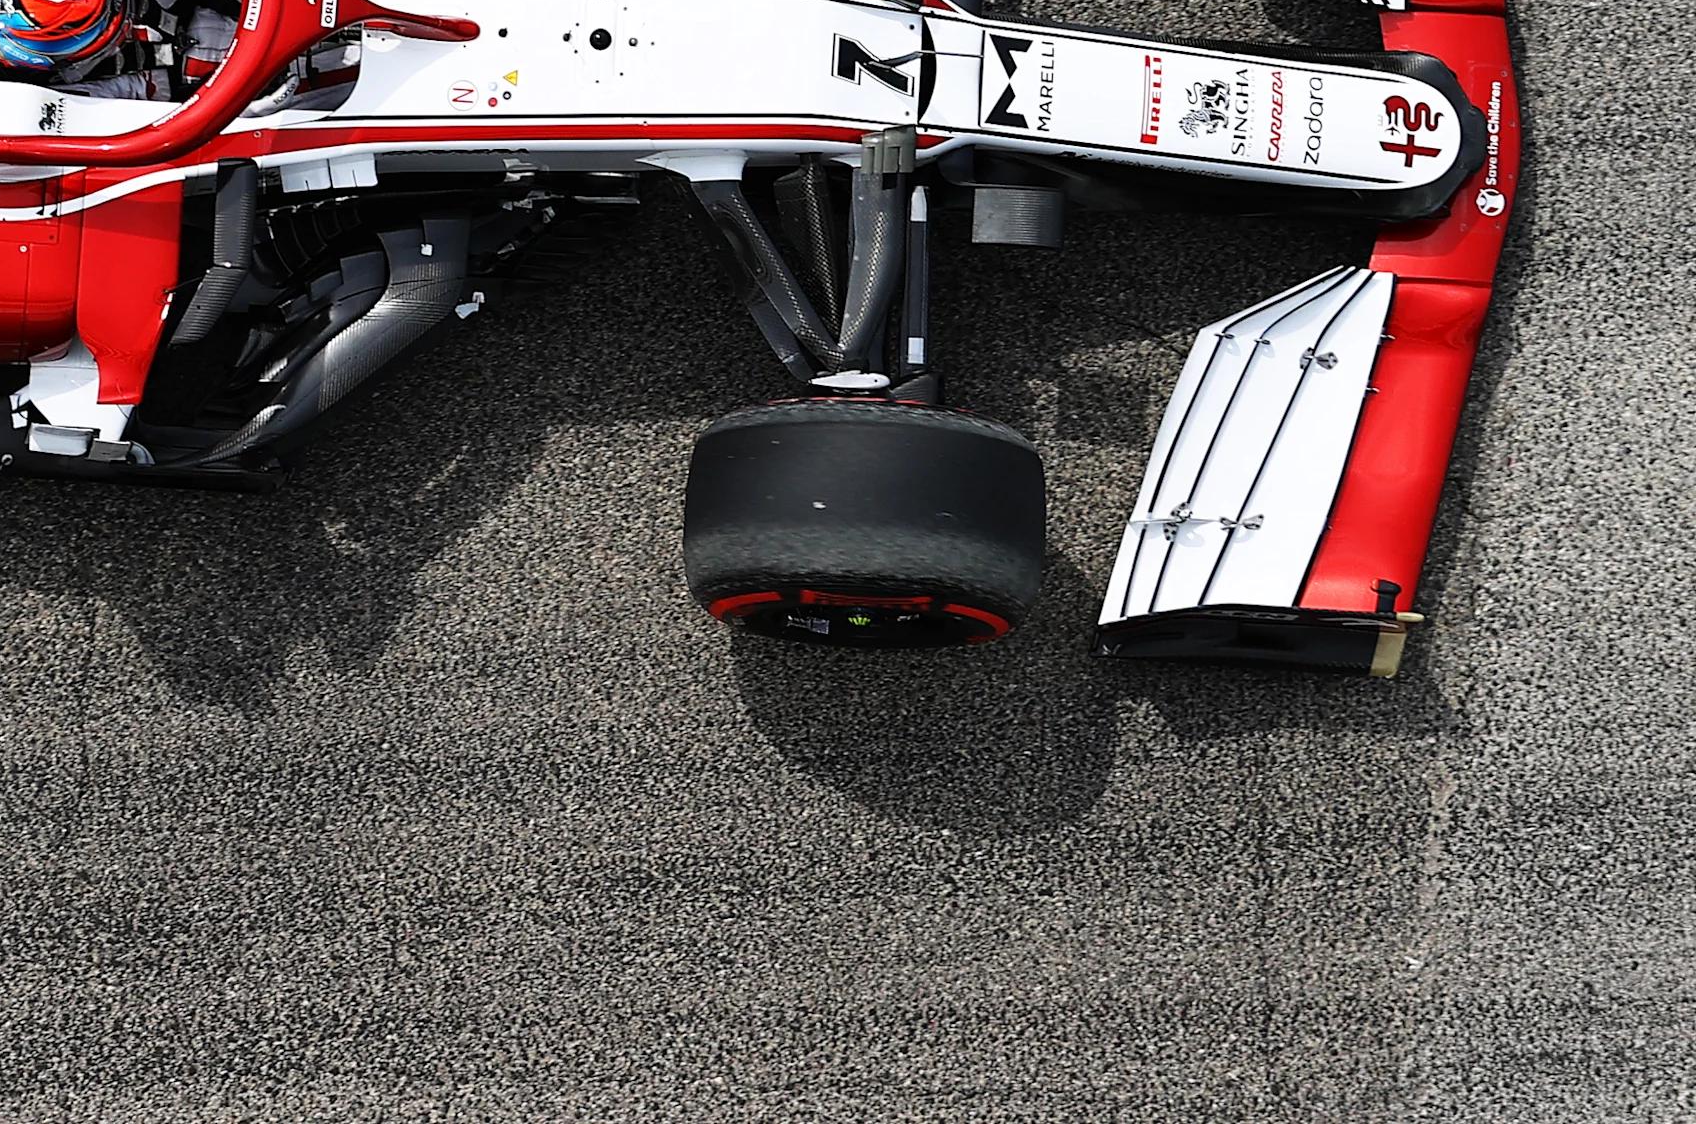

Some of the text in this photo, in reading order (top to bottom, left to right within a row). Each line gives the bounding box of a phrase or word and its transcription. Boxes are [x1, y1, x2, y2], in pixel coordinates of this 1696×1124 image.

[831, 32, 915, 98] 7
[1037, 41, 1055, 132] MARELLI
[1140, 55, 1163, 145] PIRELLI
[1231, 68, 1249, 156] SINGHA
[1267, 71, 1283, 162] CARRERA
[1303, 76, 1324, 165] zadara
[1485, 81, 1502, 186] Save the Children
